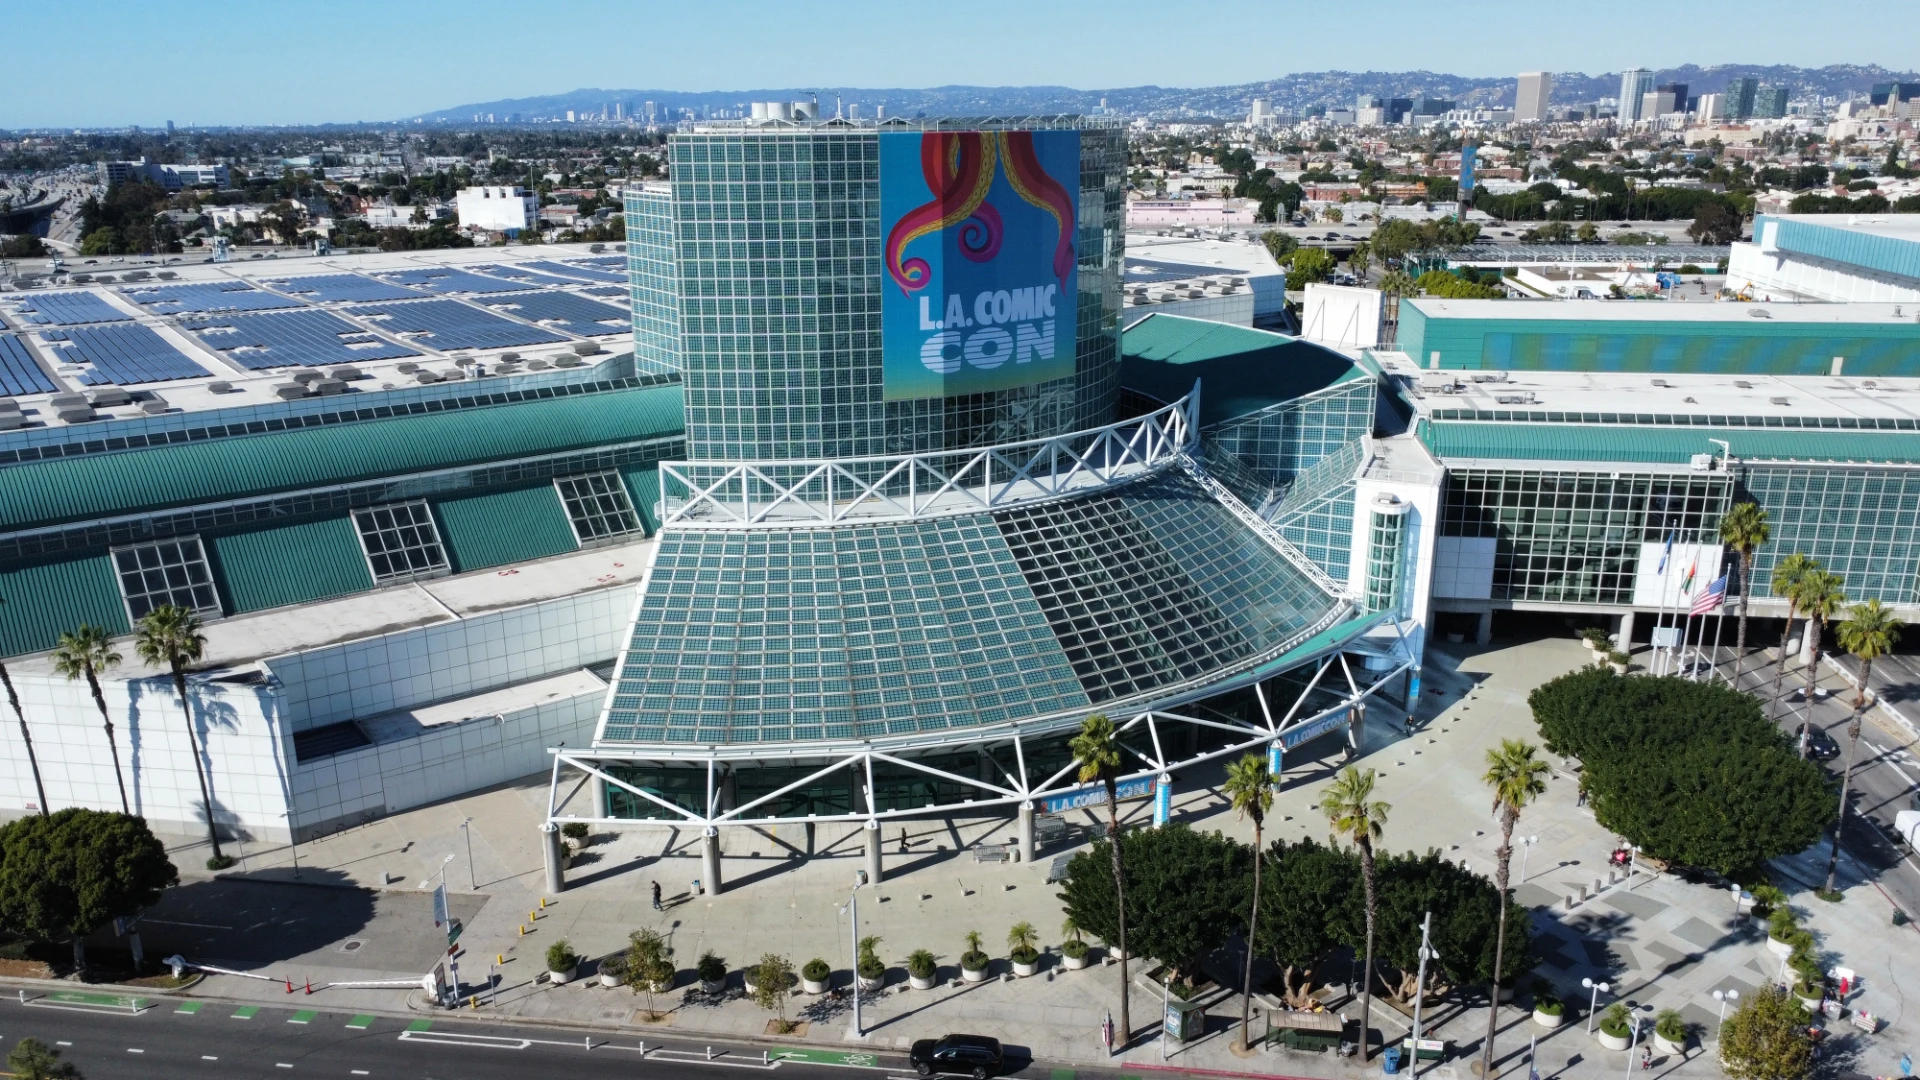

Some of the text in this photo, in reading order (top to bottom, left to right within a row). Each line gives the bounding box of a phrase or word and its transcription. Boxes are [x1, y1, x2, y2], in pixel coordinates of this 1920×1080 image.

[920, 284, 1056, 330] L.A. COMIC
[920, 320, 1056, 374] CON
[1325, 713, 1345, 730] CON
